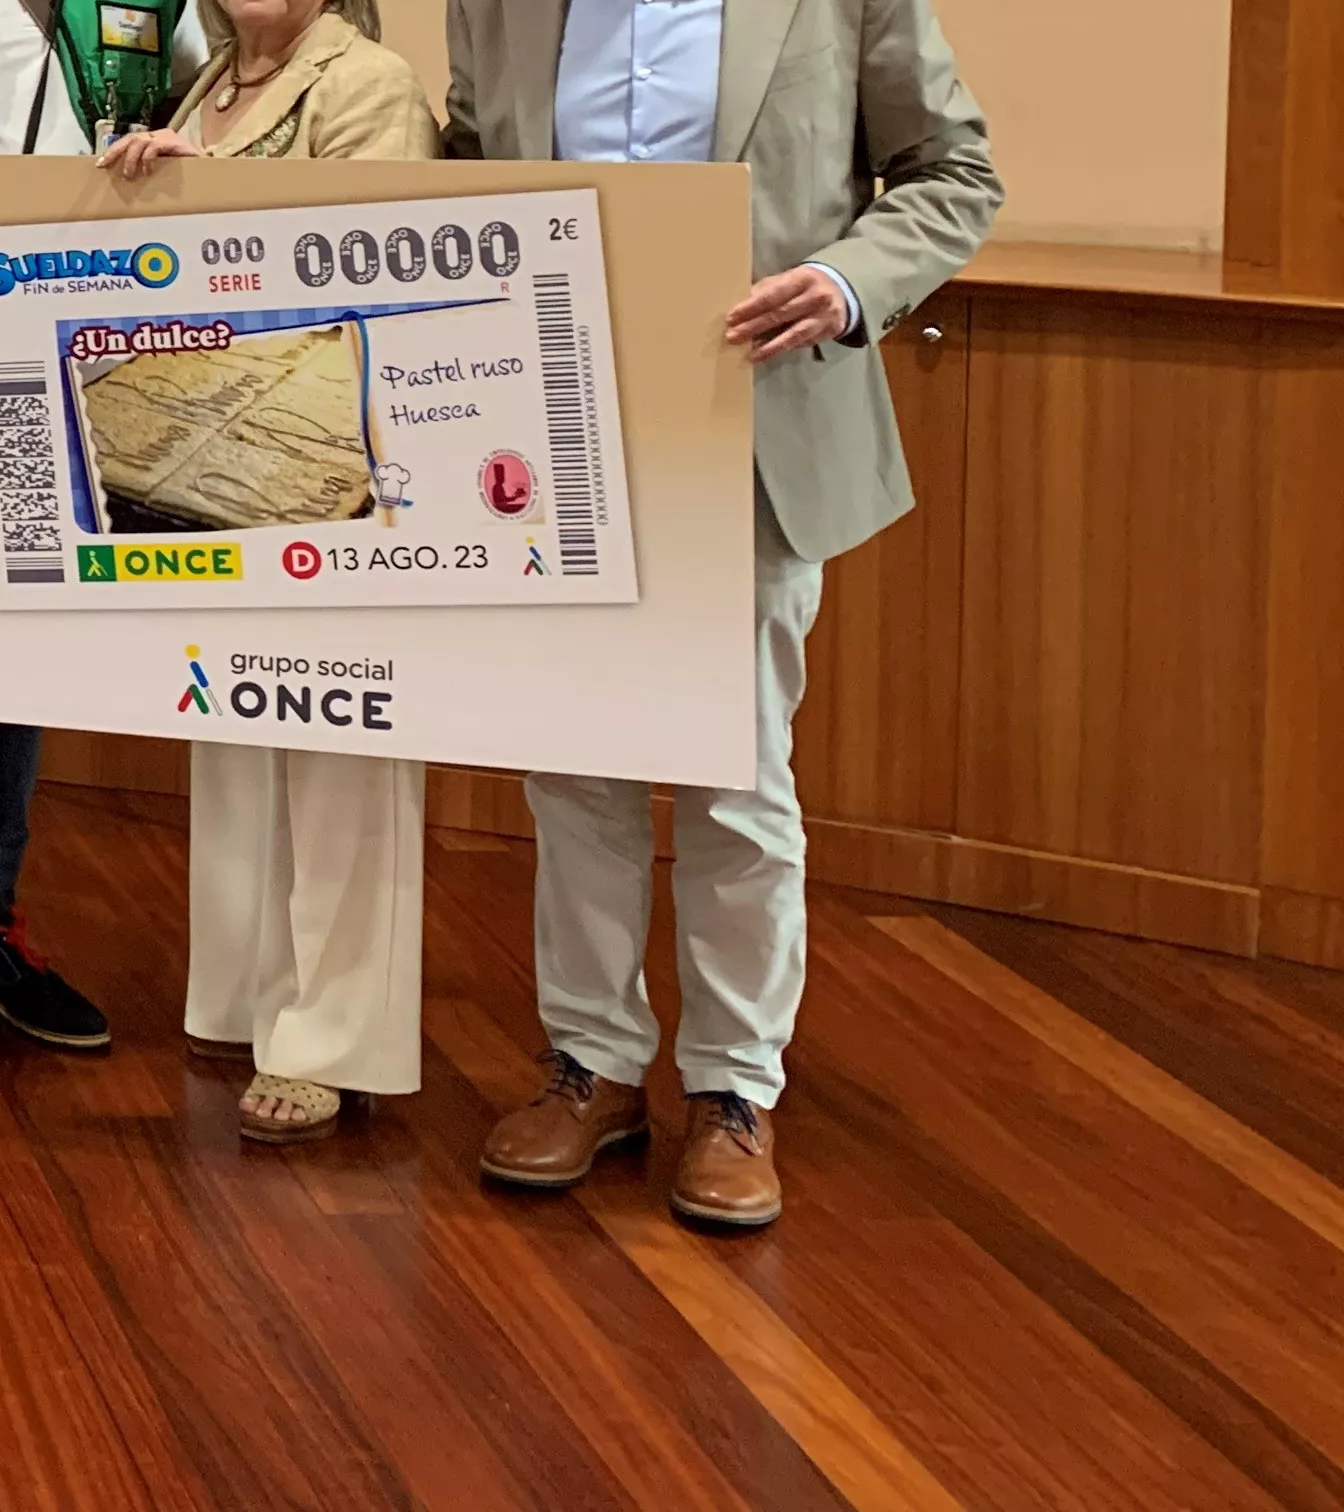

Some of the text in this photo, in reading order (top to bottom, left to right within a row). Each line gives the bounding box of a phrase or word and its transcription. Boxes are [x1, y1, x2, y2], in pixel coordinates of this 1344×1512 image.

[549, 218, 579, 241] 2€
[201, 236, 265, 265] 000
[294, 221, 521, 287] 00000
[52, 284, 64, 294] de
[68, 279, 133, 293] SEMANA
[209, 274, 261, 292] SERIE
[501, 282, 509, 293] R
[73, 324, 230, 357] ¿Un dulce?
[380, 357, 523, 389] Pastel ruso
[390, 402, 481, 426] Huesca
[125, 548, 234, 575] ONCE
[291, 544, 488, 572] D 13 AGO. 23
[230, 653, 393, 681] grupo social
[230, 681, 392, 730] ONCE
